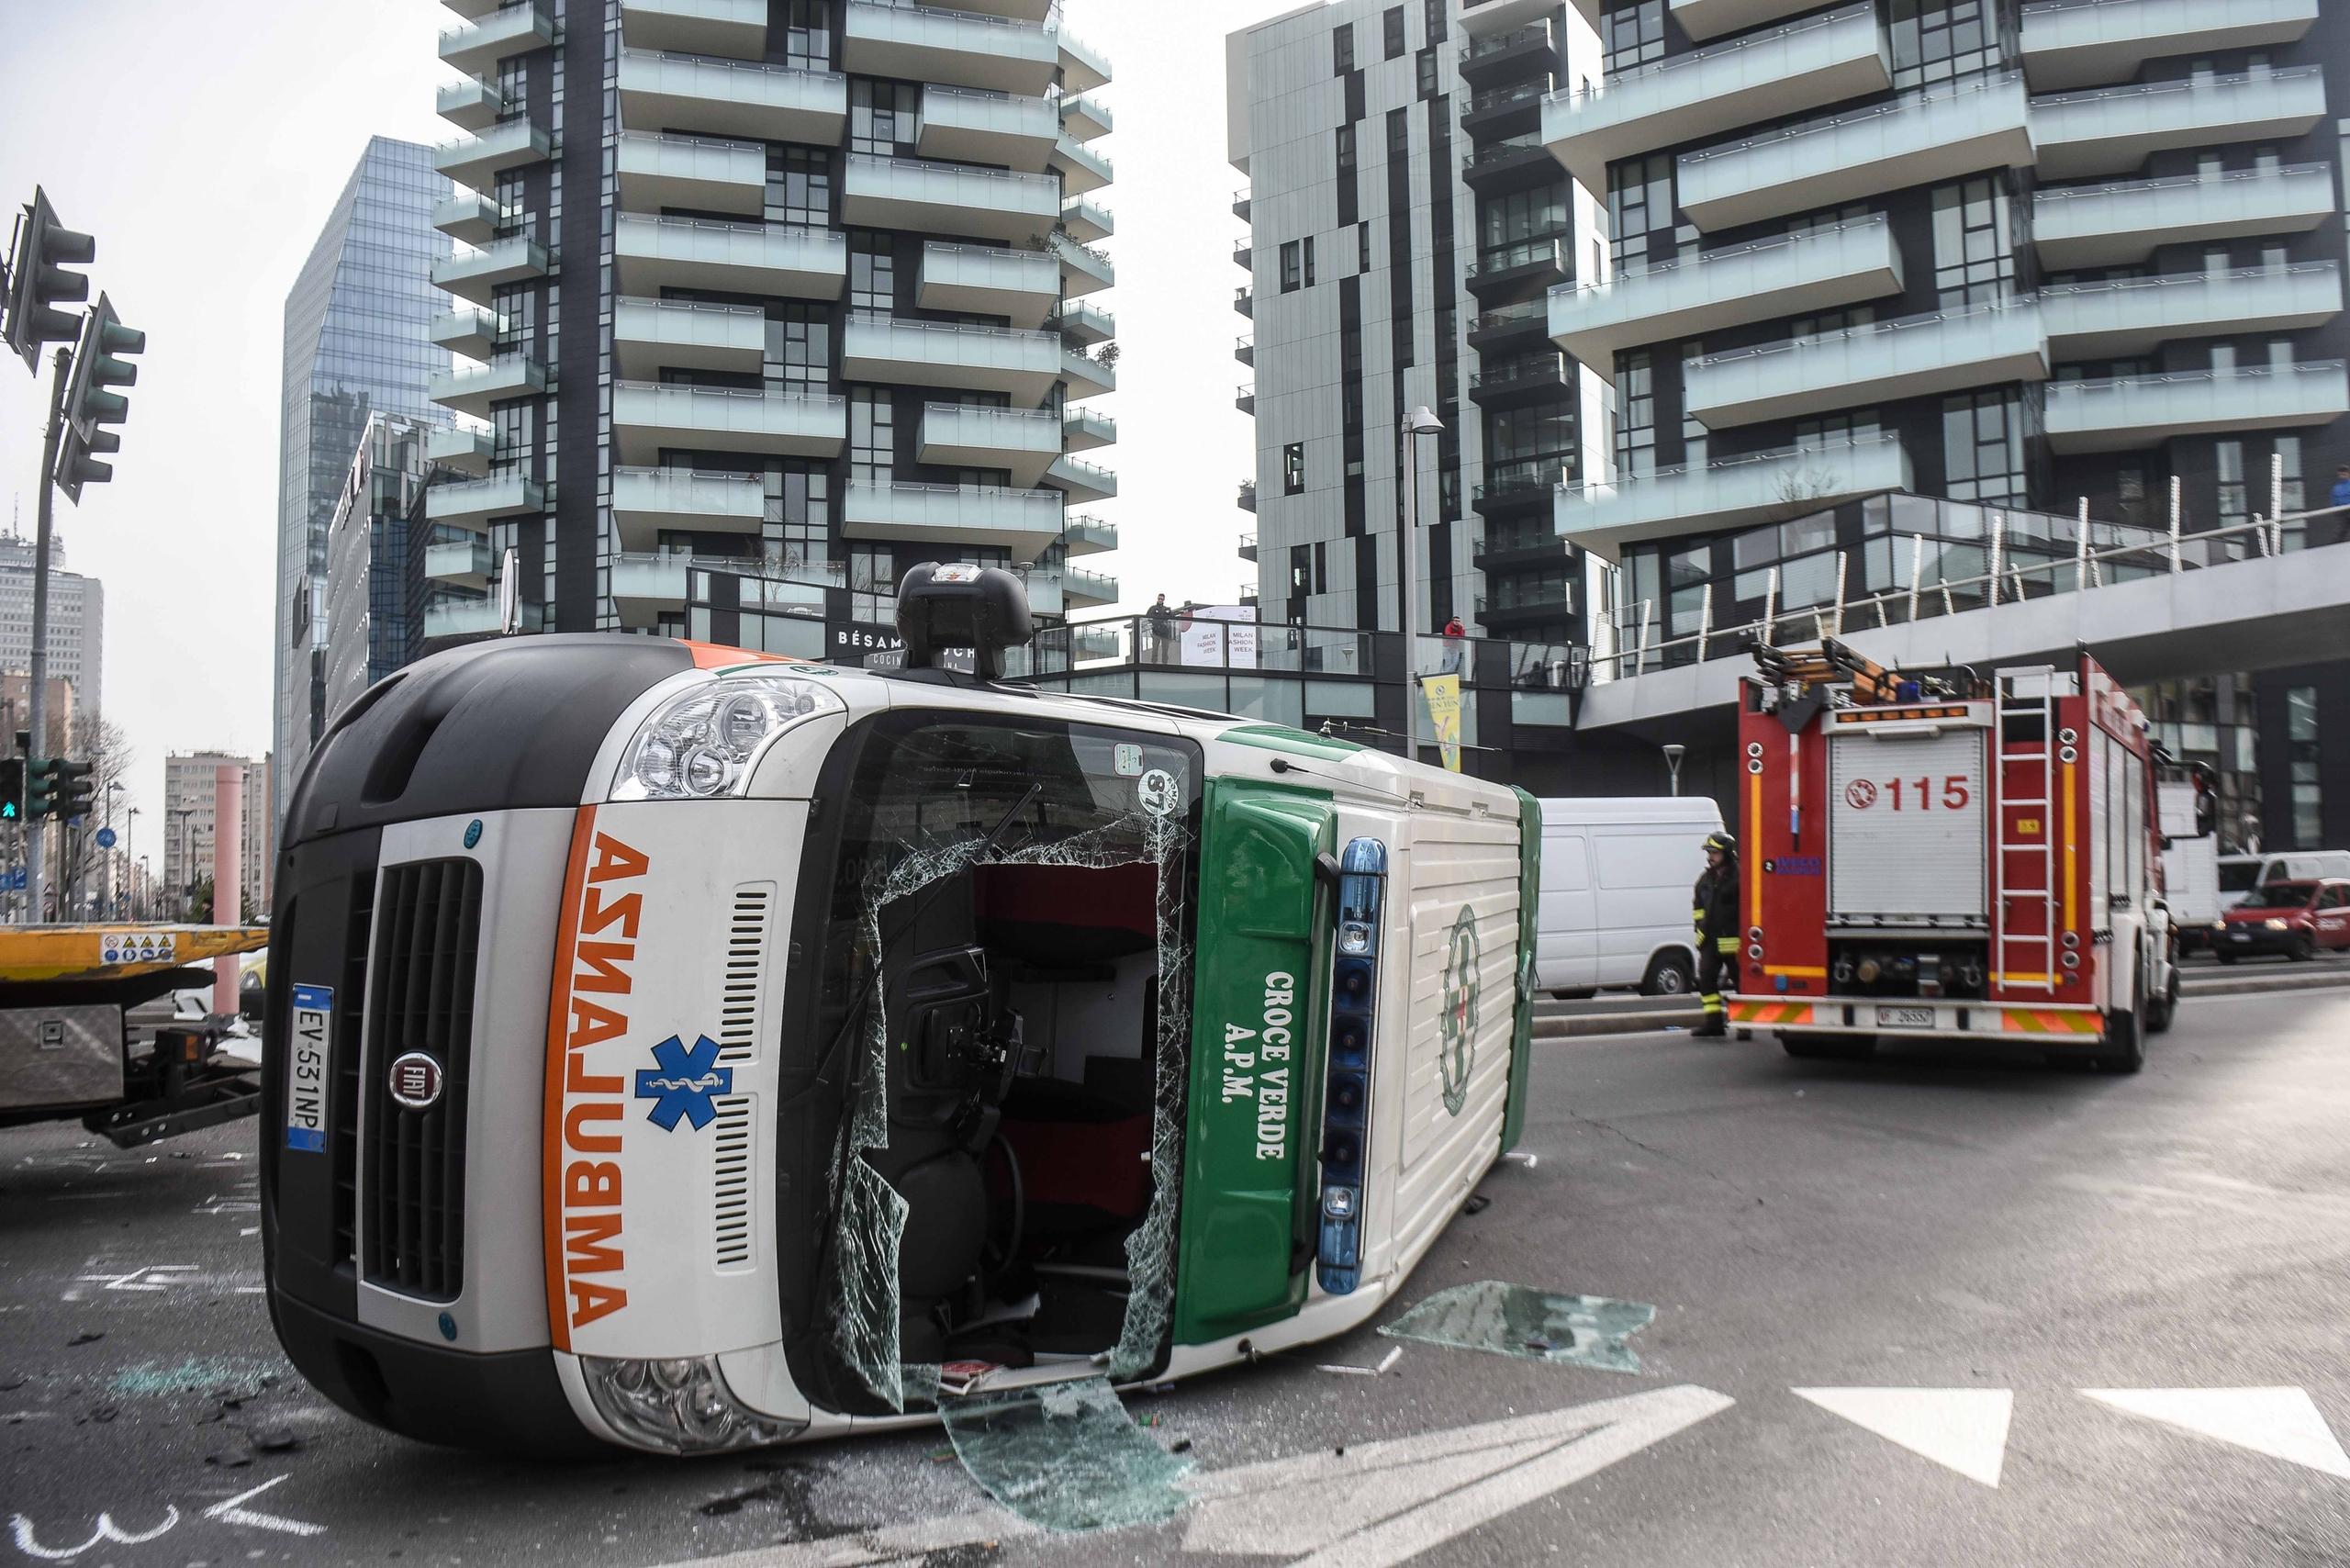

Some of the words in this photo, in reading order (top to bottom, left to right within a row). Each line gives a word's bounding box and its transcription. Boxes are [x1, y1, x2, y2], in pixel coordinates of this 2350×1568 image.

[837, 630, 901, 649] BÉSAM
[1197, 640, 1216, 648] FASHION
[873, 654, 901, 666] COCIN
[1146, 774, 1165, 811] 87
[1885, 775, 1970, 812] 115
[1261, 971, 1294, 1061] CROCE
[1222, 1023, 1257, 1103] A.P.M.
[402, 1066, 427, 1098] FIAT
[1256, 1068, 1289, 1160] VERDE
